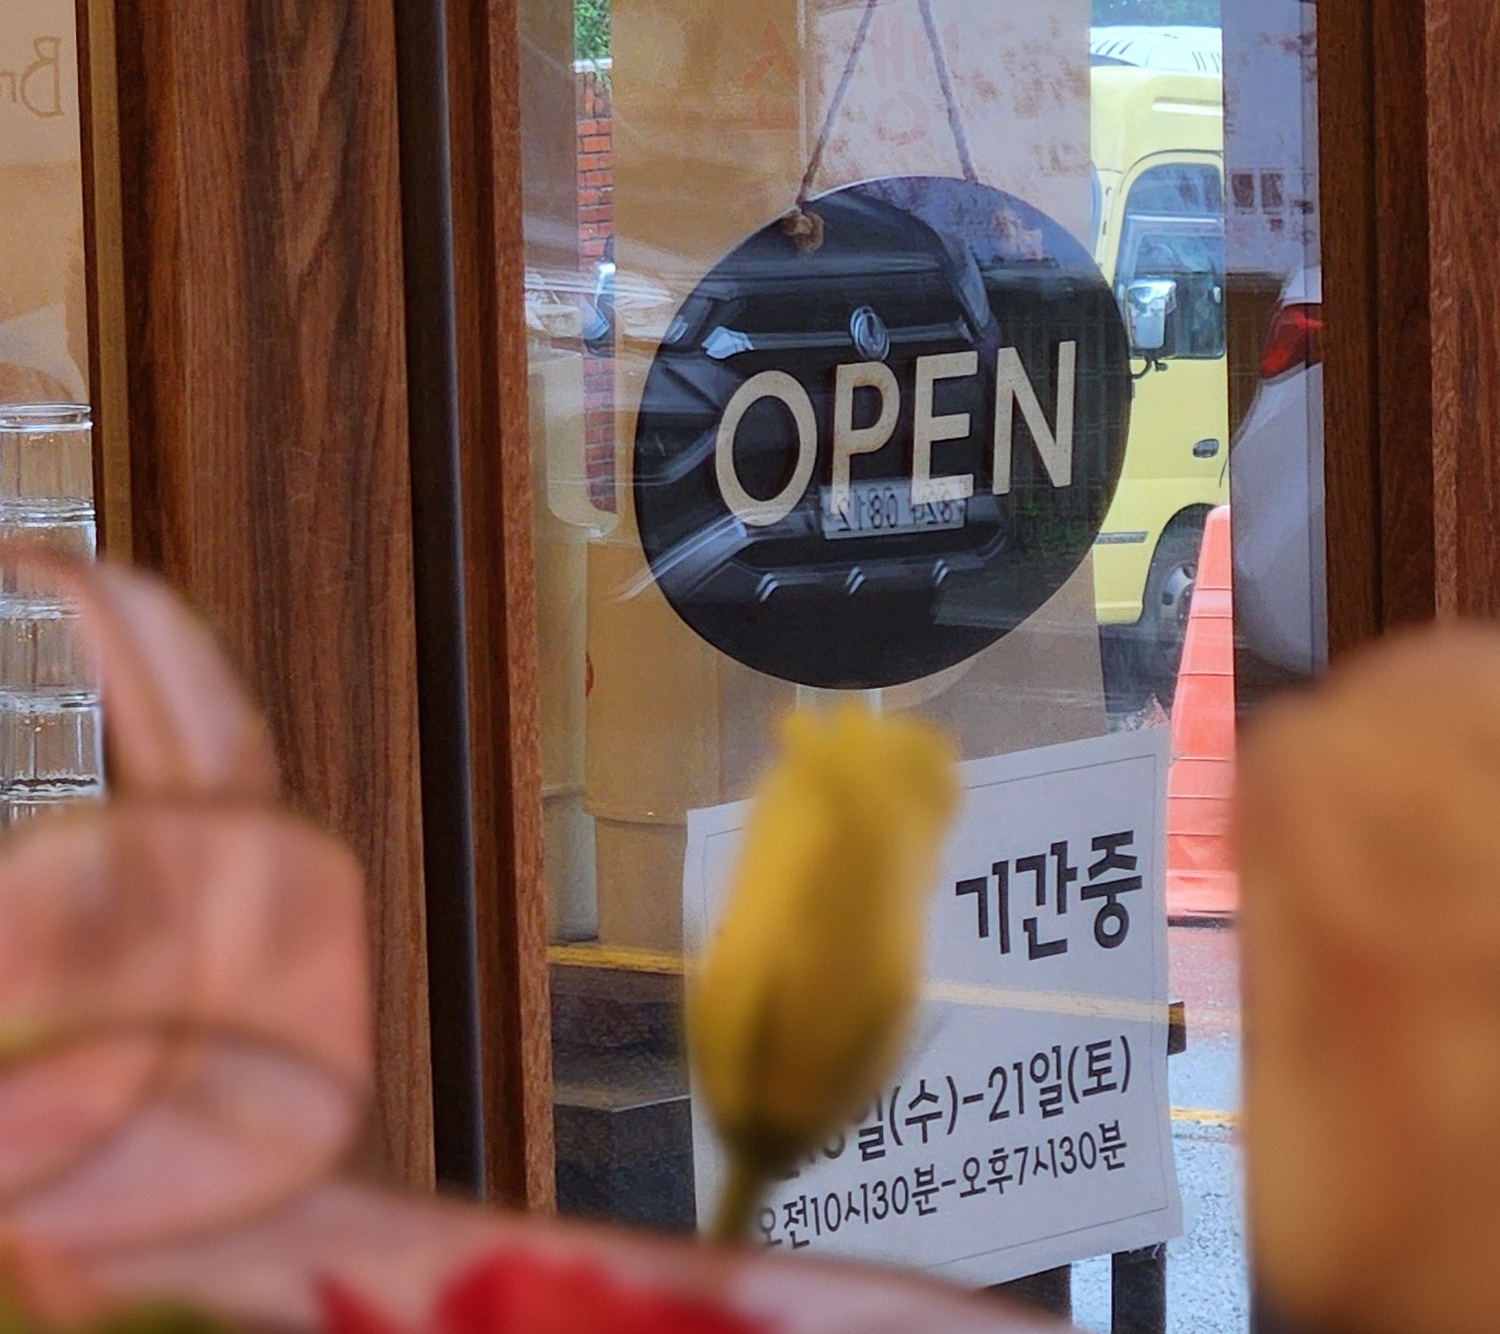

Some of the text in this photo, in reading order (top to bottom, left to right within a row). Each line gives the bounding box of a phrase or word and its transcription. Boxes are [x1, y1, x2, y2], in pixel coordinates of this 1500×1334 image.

[714, 340, 1077, 527] OPEN
[955, 829, 1143, 961] 기간중
[815, 1034, 1132, 1162] 일(수)-21일(토)
[757, 1119, 1128, 1250] 오전10시30분-오후7시30분
